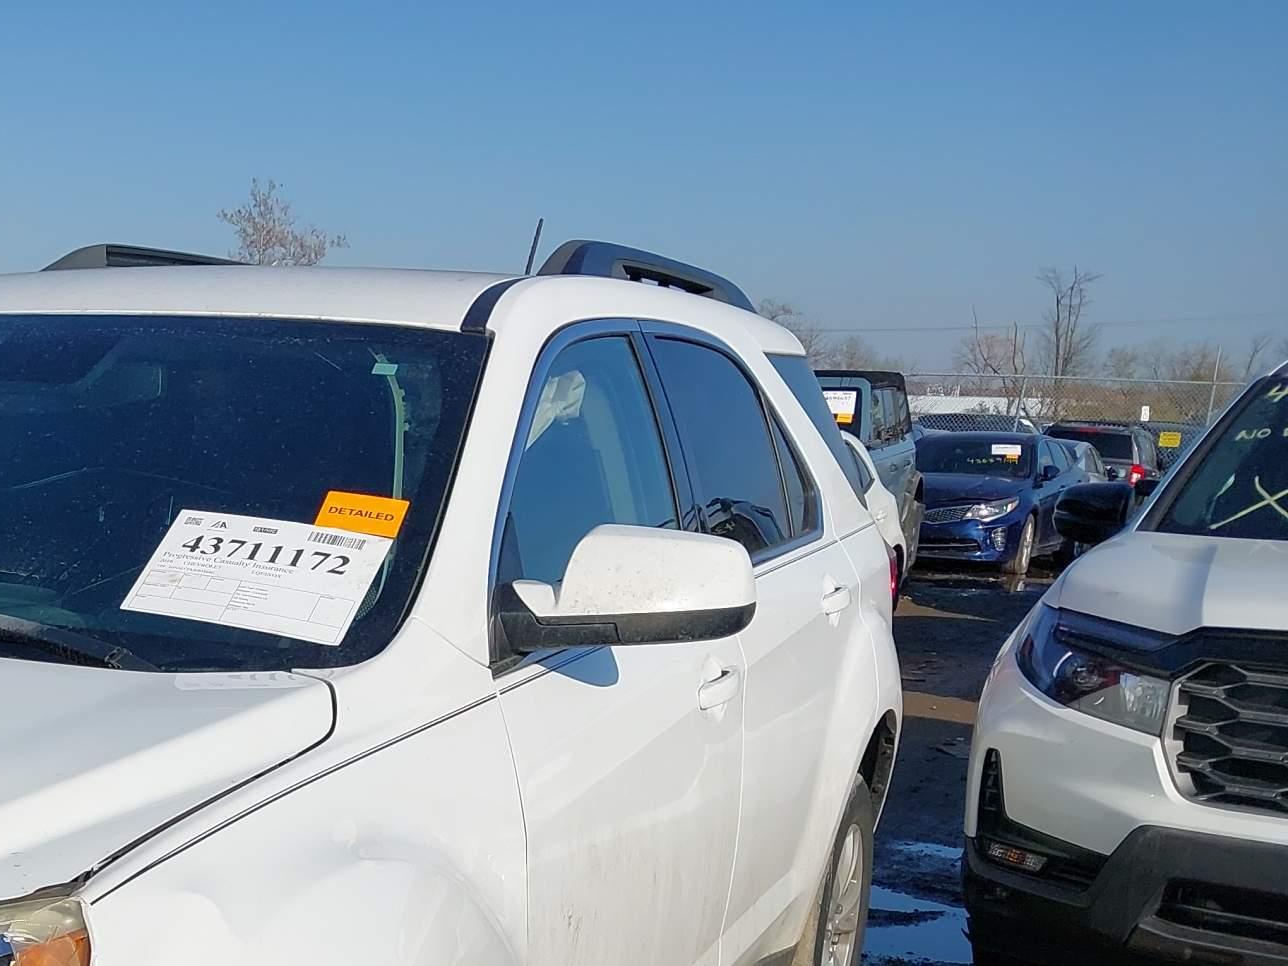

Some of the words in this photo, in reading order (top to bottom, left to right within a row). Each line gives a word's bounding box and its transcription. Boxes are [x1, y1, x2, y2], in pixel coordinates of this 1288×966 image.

[328, 506, 395, 522] DETAILED
[162, 551, 212, 563] Progressive
[213, 557, 251, 569] Casualty
[252, 562, 295, 575] Insurance
[181, 535, 351, 576] 43711172
